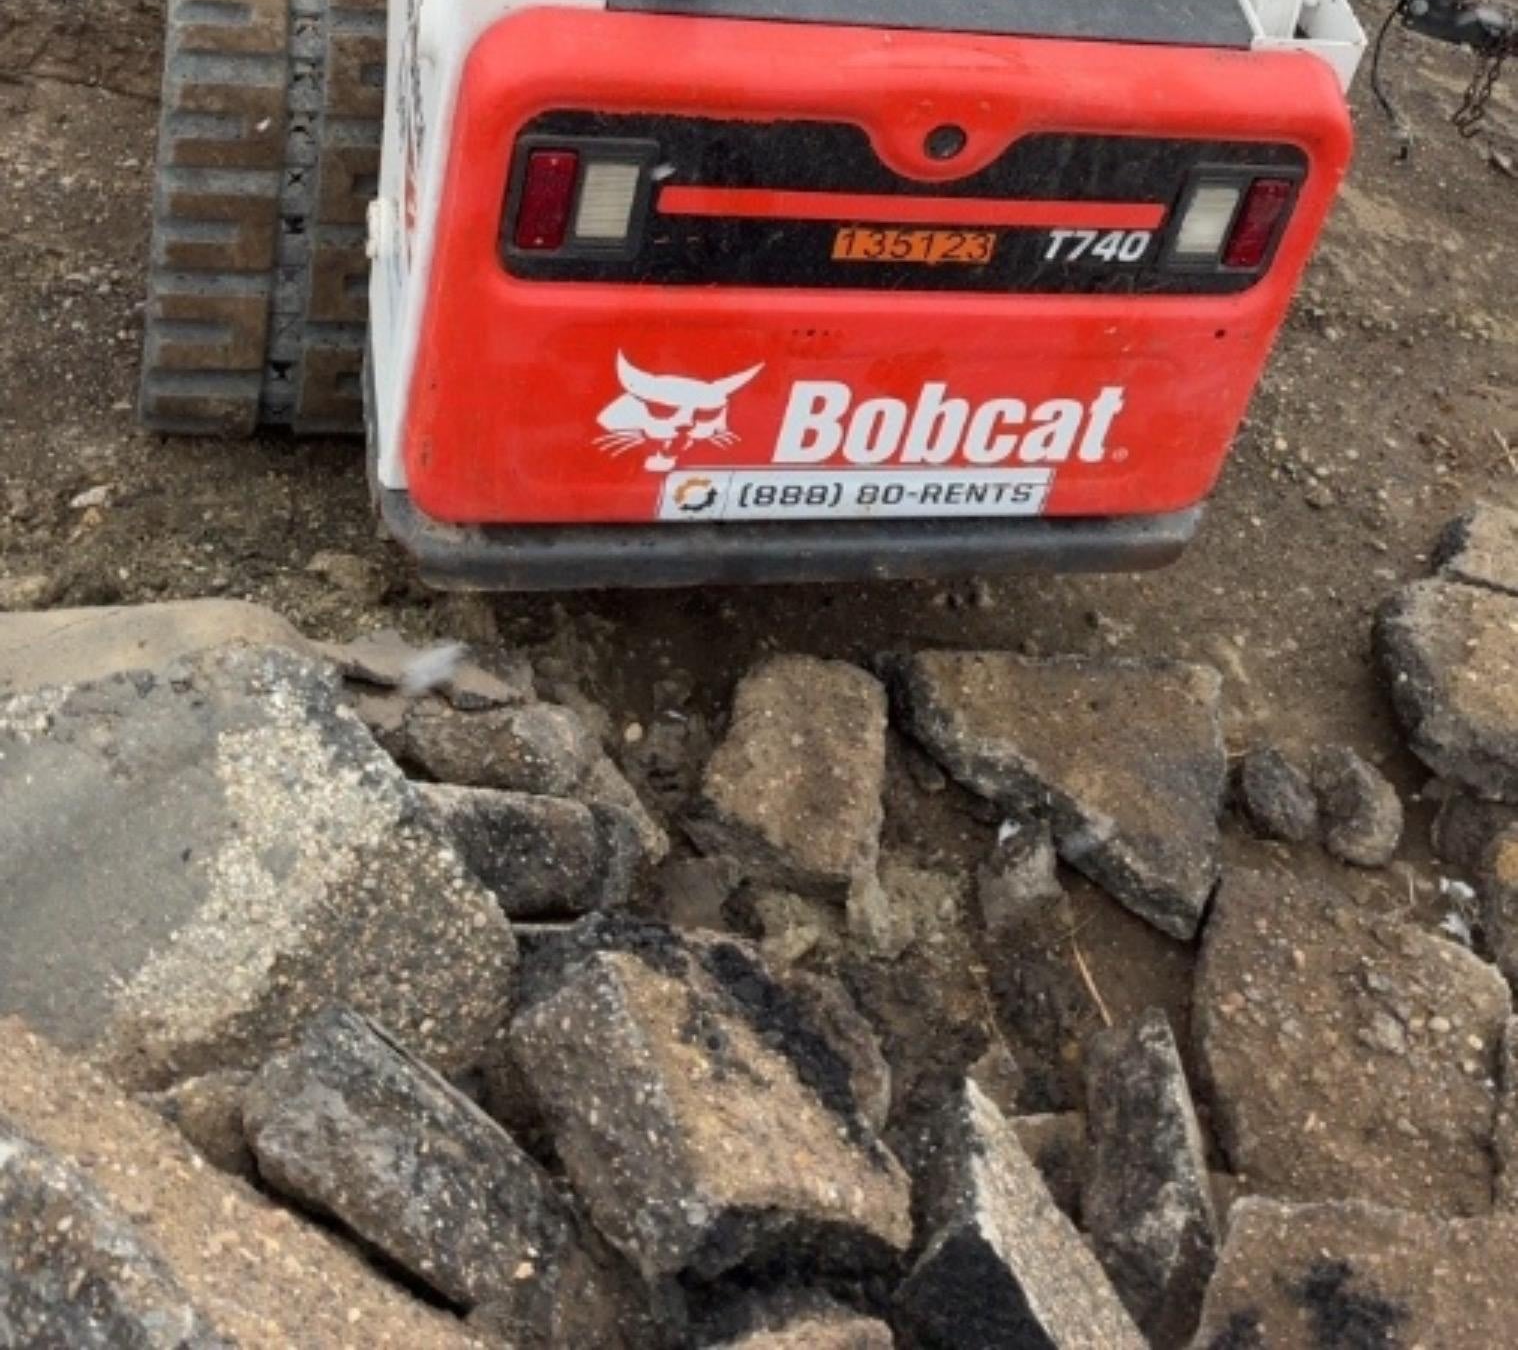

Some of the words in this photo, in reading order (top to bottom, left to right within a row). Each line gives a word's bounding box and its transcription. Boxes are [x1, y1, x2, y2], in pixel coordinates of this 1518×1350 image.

[842, 230, 992, 260] 135123
[1045, 229, 1151, 262] T740
[773, 380, 1124, 464] Bobcat
[738, 484, 841, 508] (888)
[856, 482, 1033, 506] 80-RENTS
